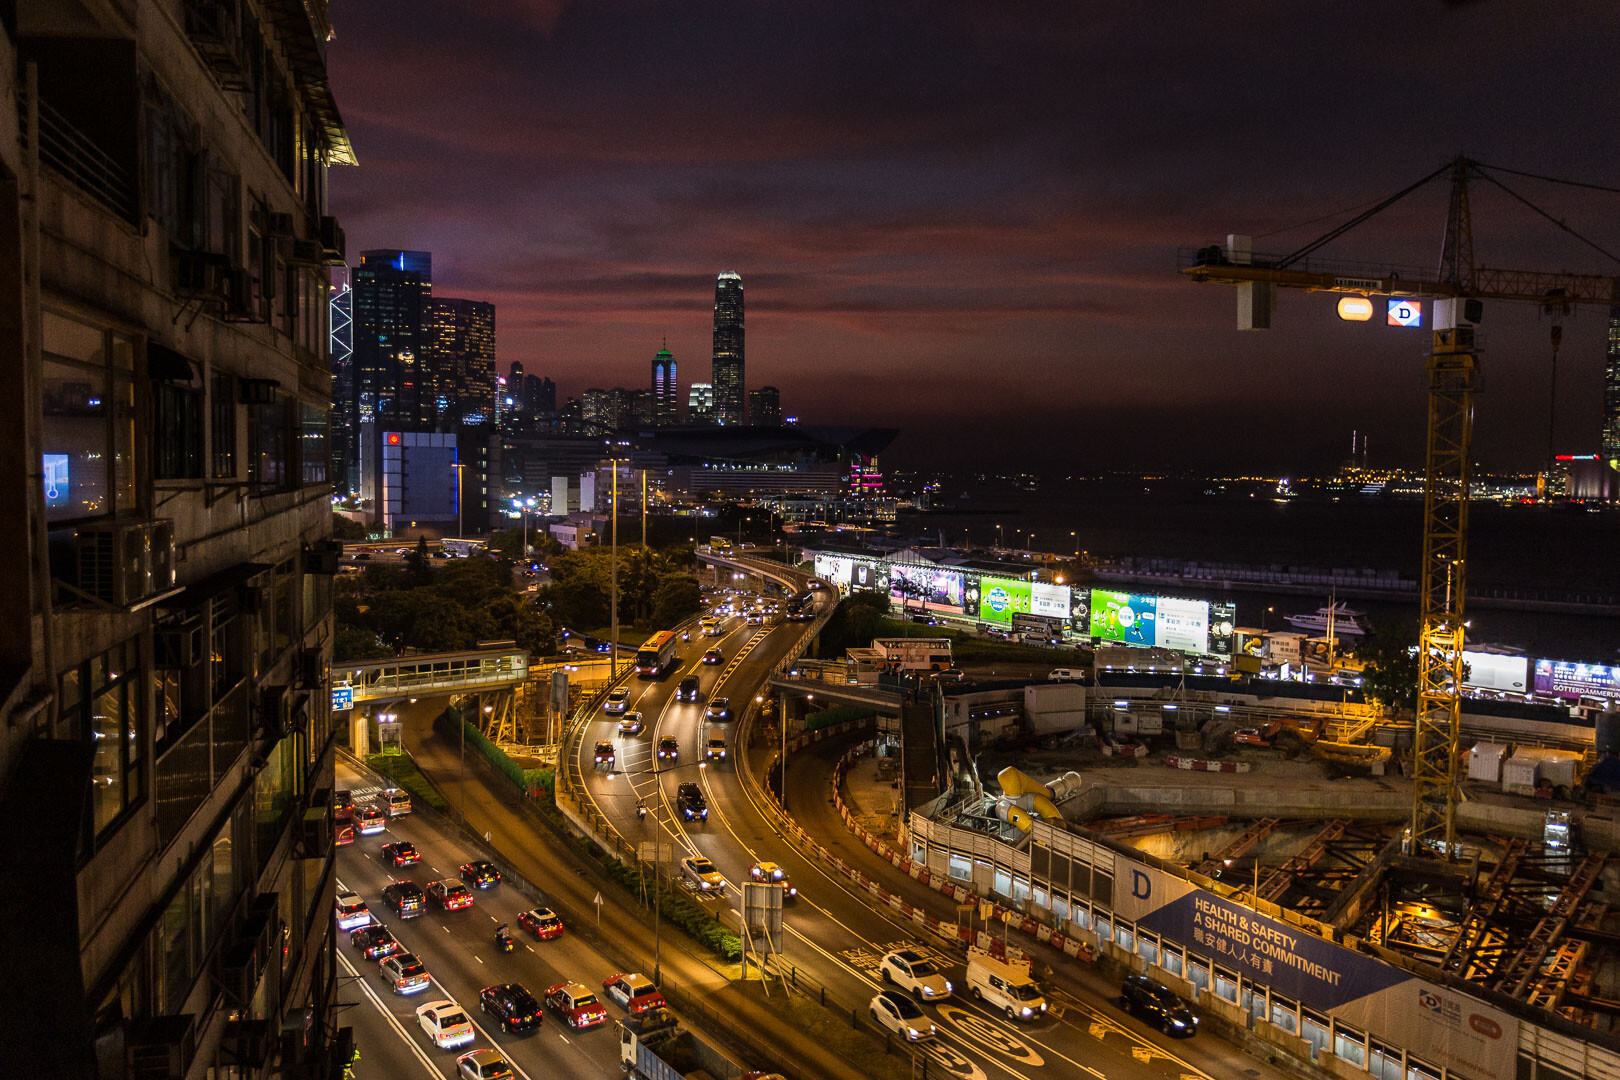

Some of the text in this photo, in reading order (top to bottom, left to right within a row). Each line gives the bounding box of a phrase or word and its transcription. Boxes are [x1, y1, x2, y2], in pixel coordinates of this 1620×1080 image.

[1399, 308, 1411, 319] D
[1131, 868, 1151, 900] D
[1193, 912, 1342, 986] A SHARED COMMITMENT
[1195, 897, 1298, 951] HEALTH & SAFETY
[1193, 927, 1273, 977] 職安健人人有責
